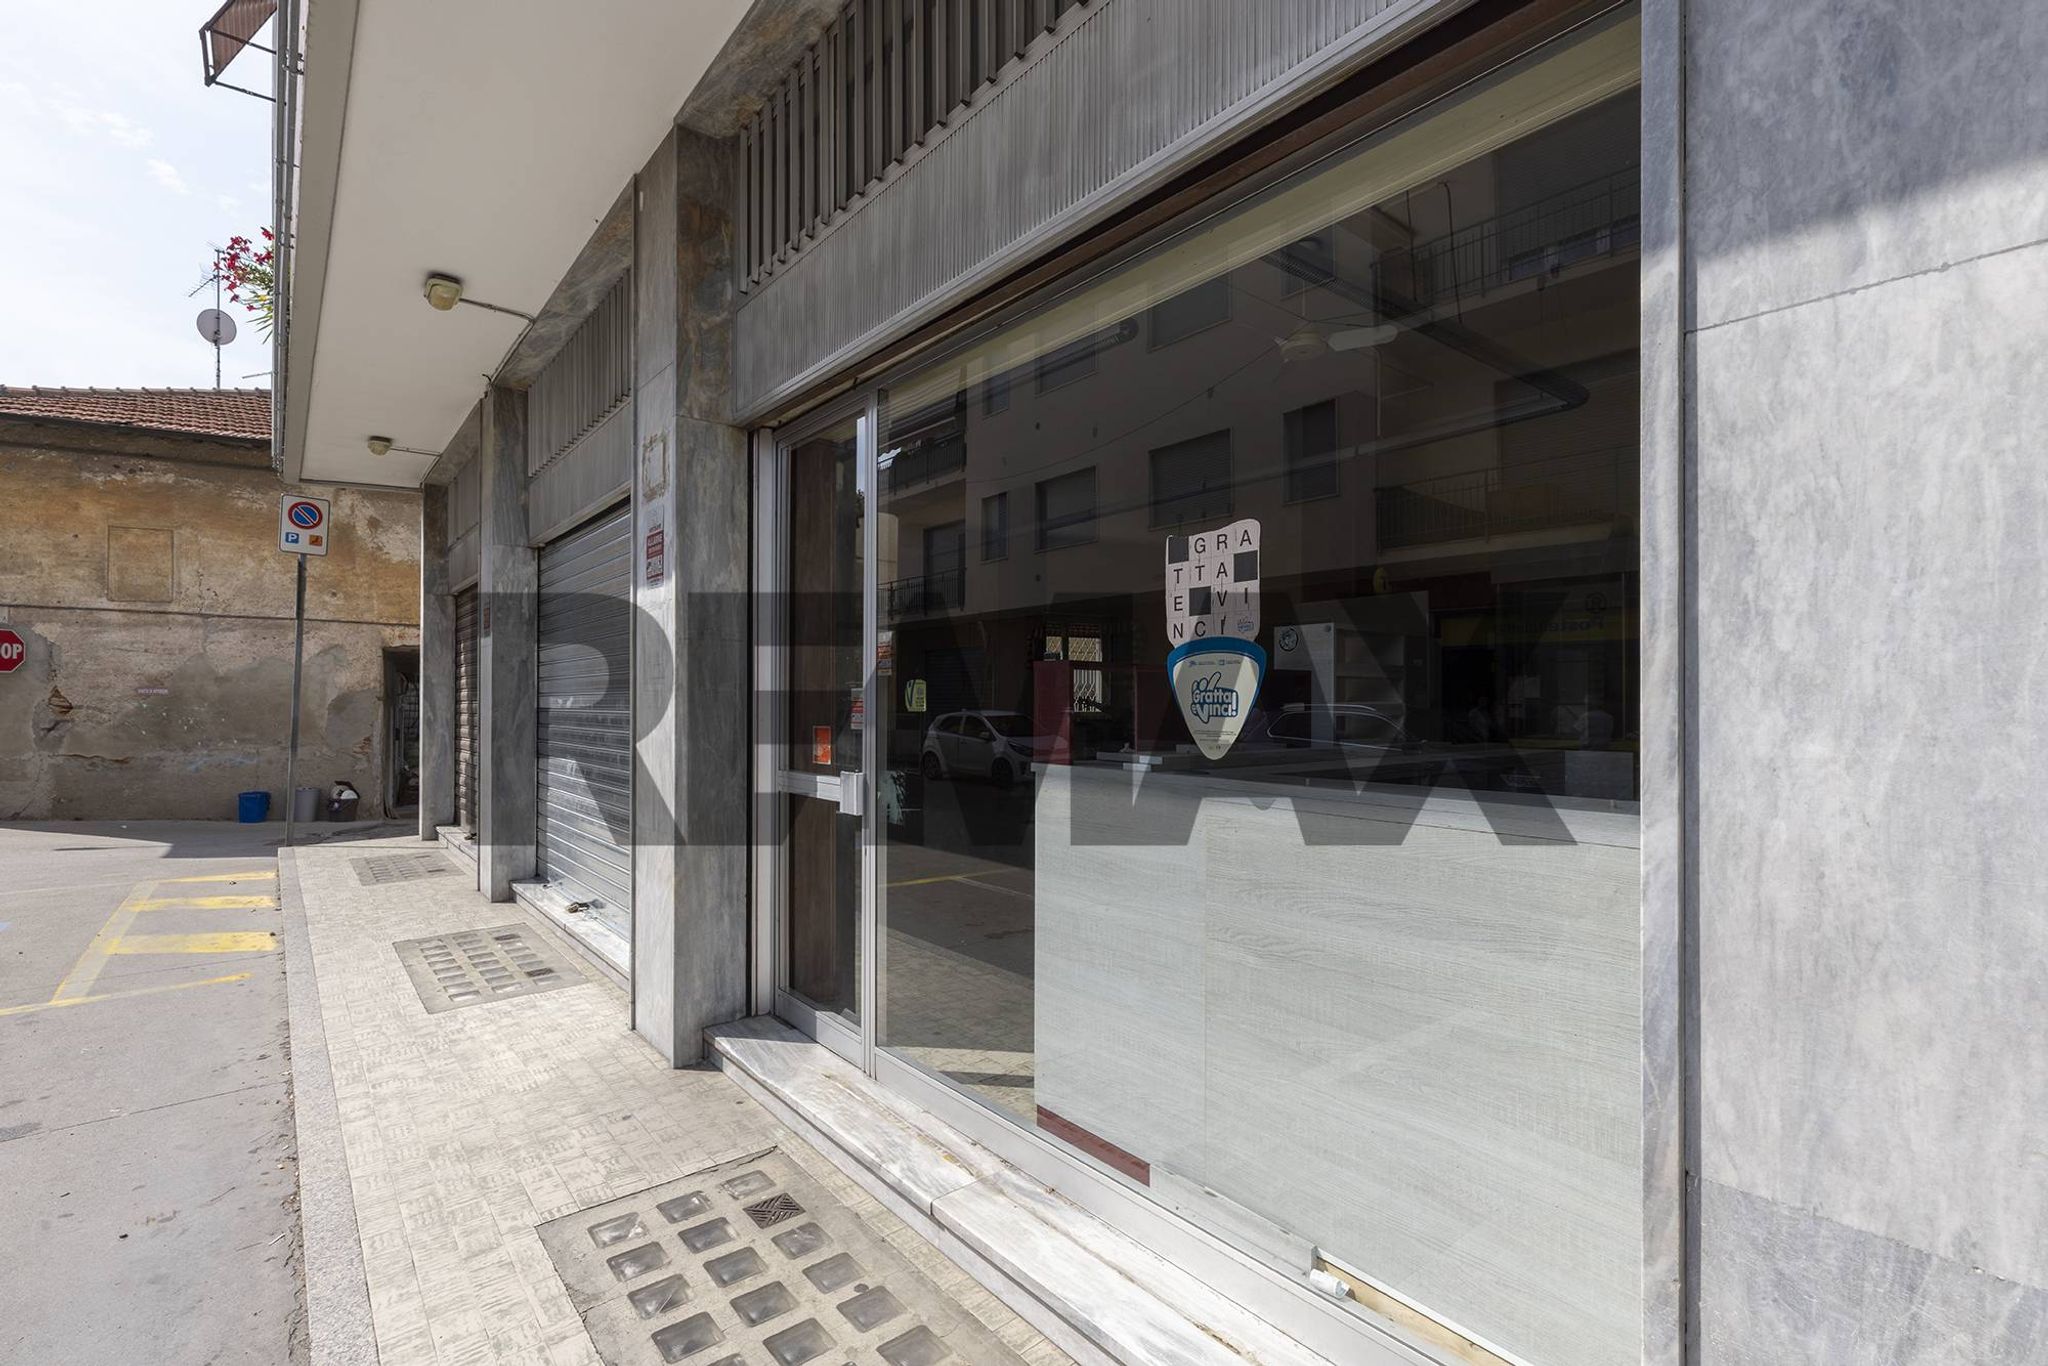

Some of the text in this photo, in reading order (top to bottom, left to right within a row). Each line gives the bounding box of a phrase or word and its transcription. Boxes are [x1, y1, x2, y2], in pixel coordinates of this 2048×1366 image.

[288, 532, 298, 542] P
[0, 643, 22, 659] OP
[1193, 688, 1232, 703] Gratta
